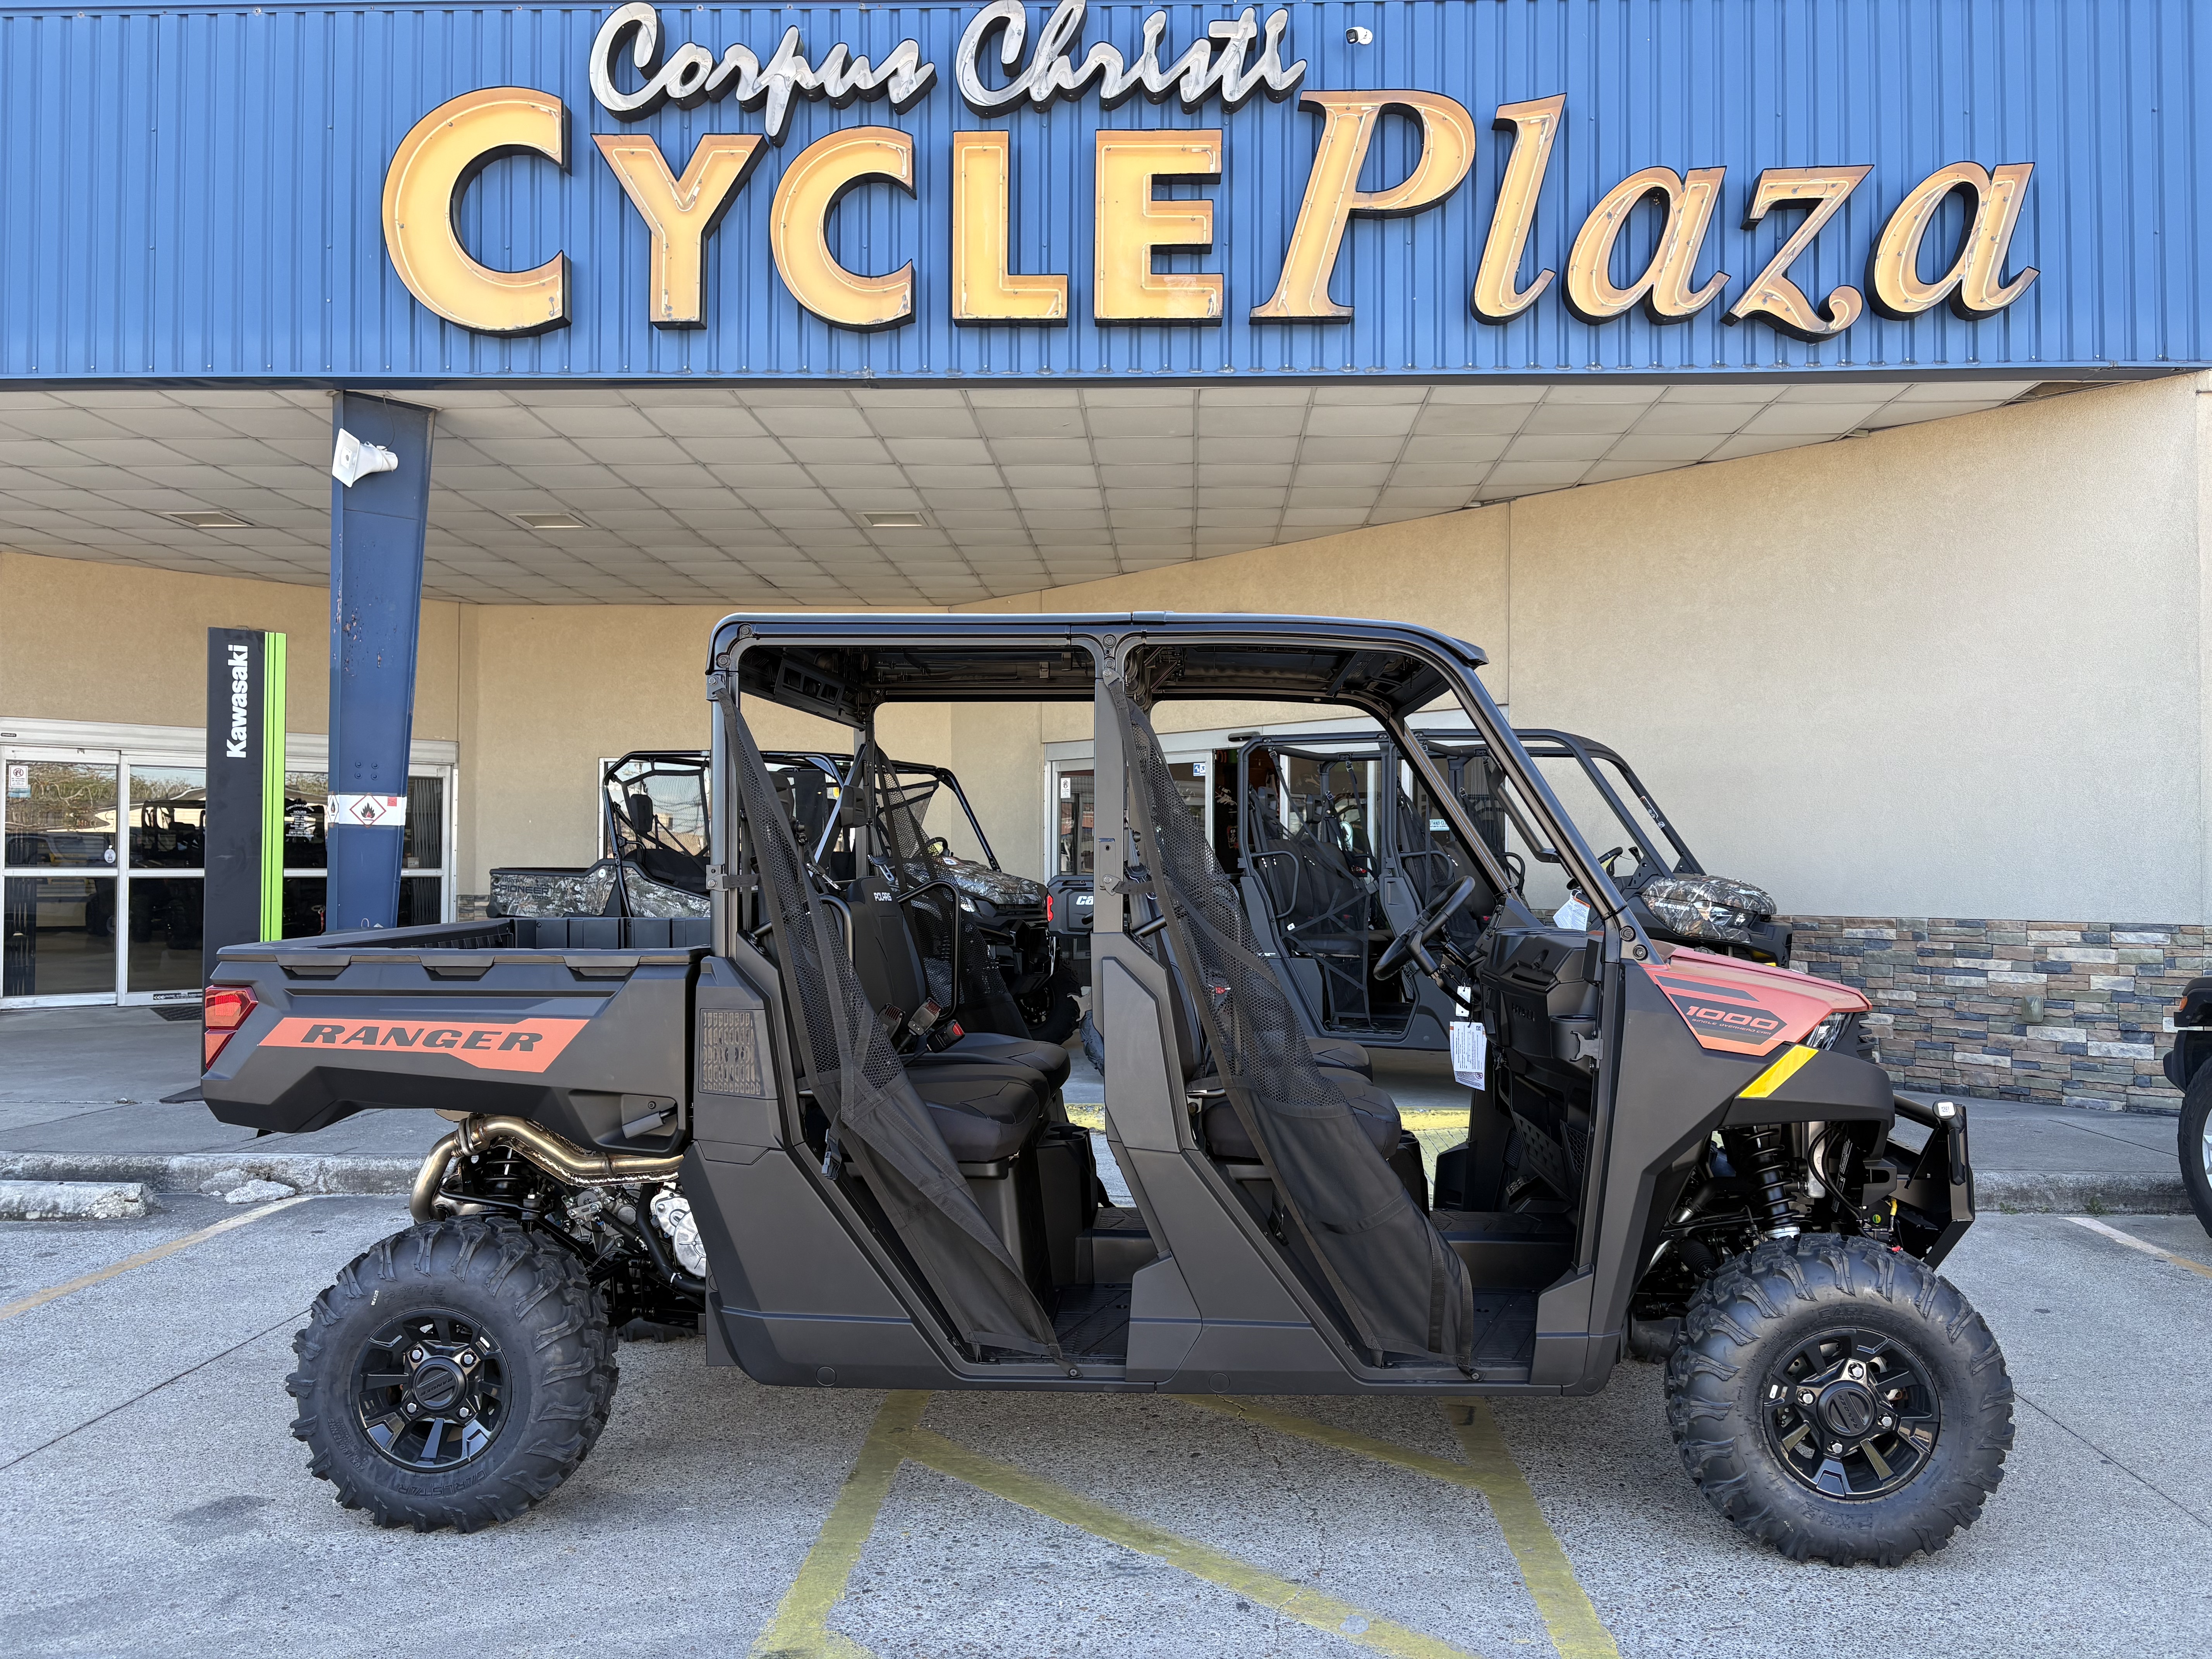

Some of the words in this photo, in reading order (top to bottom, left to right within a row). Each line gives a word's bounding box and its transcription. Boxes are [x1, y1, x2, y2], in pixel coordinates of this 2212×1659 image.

[589, 2, 936, 139] Corpus
[955, 0, 1306, 116] Christi
[383, 86, 1223, 336] CYCLE
[1250, 89, 2042, 341] Plaza
[226, 644, 248, 758] Kawasaki
[500, 884, 549, 895] PIONEER
[874, 892, 892, 901] POLARIS
[1655, 902, 1690, 911] DEFENDER
[1686, 1006, 1778, 1030] 1000
[1719, 1023, 1755, 1032] OVERHEAD
[301, 1025, 543, 1051] RANGER
[420, 1377, 453, 1396] RANGER
[1838, 1395, 1859, 1429] RANGER
[398, 1470, 487, 1497] CARLSTAR
